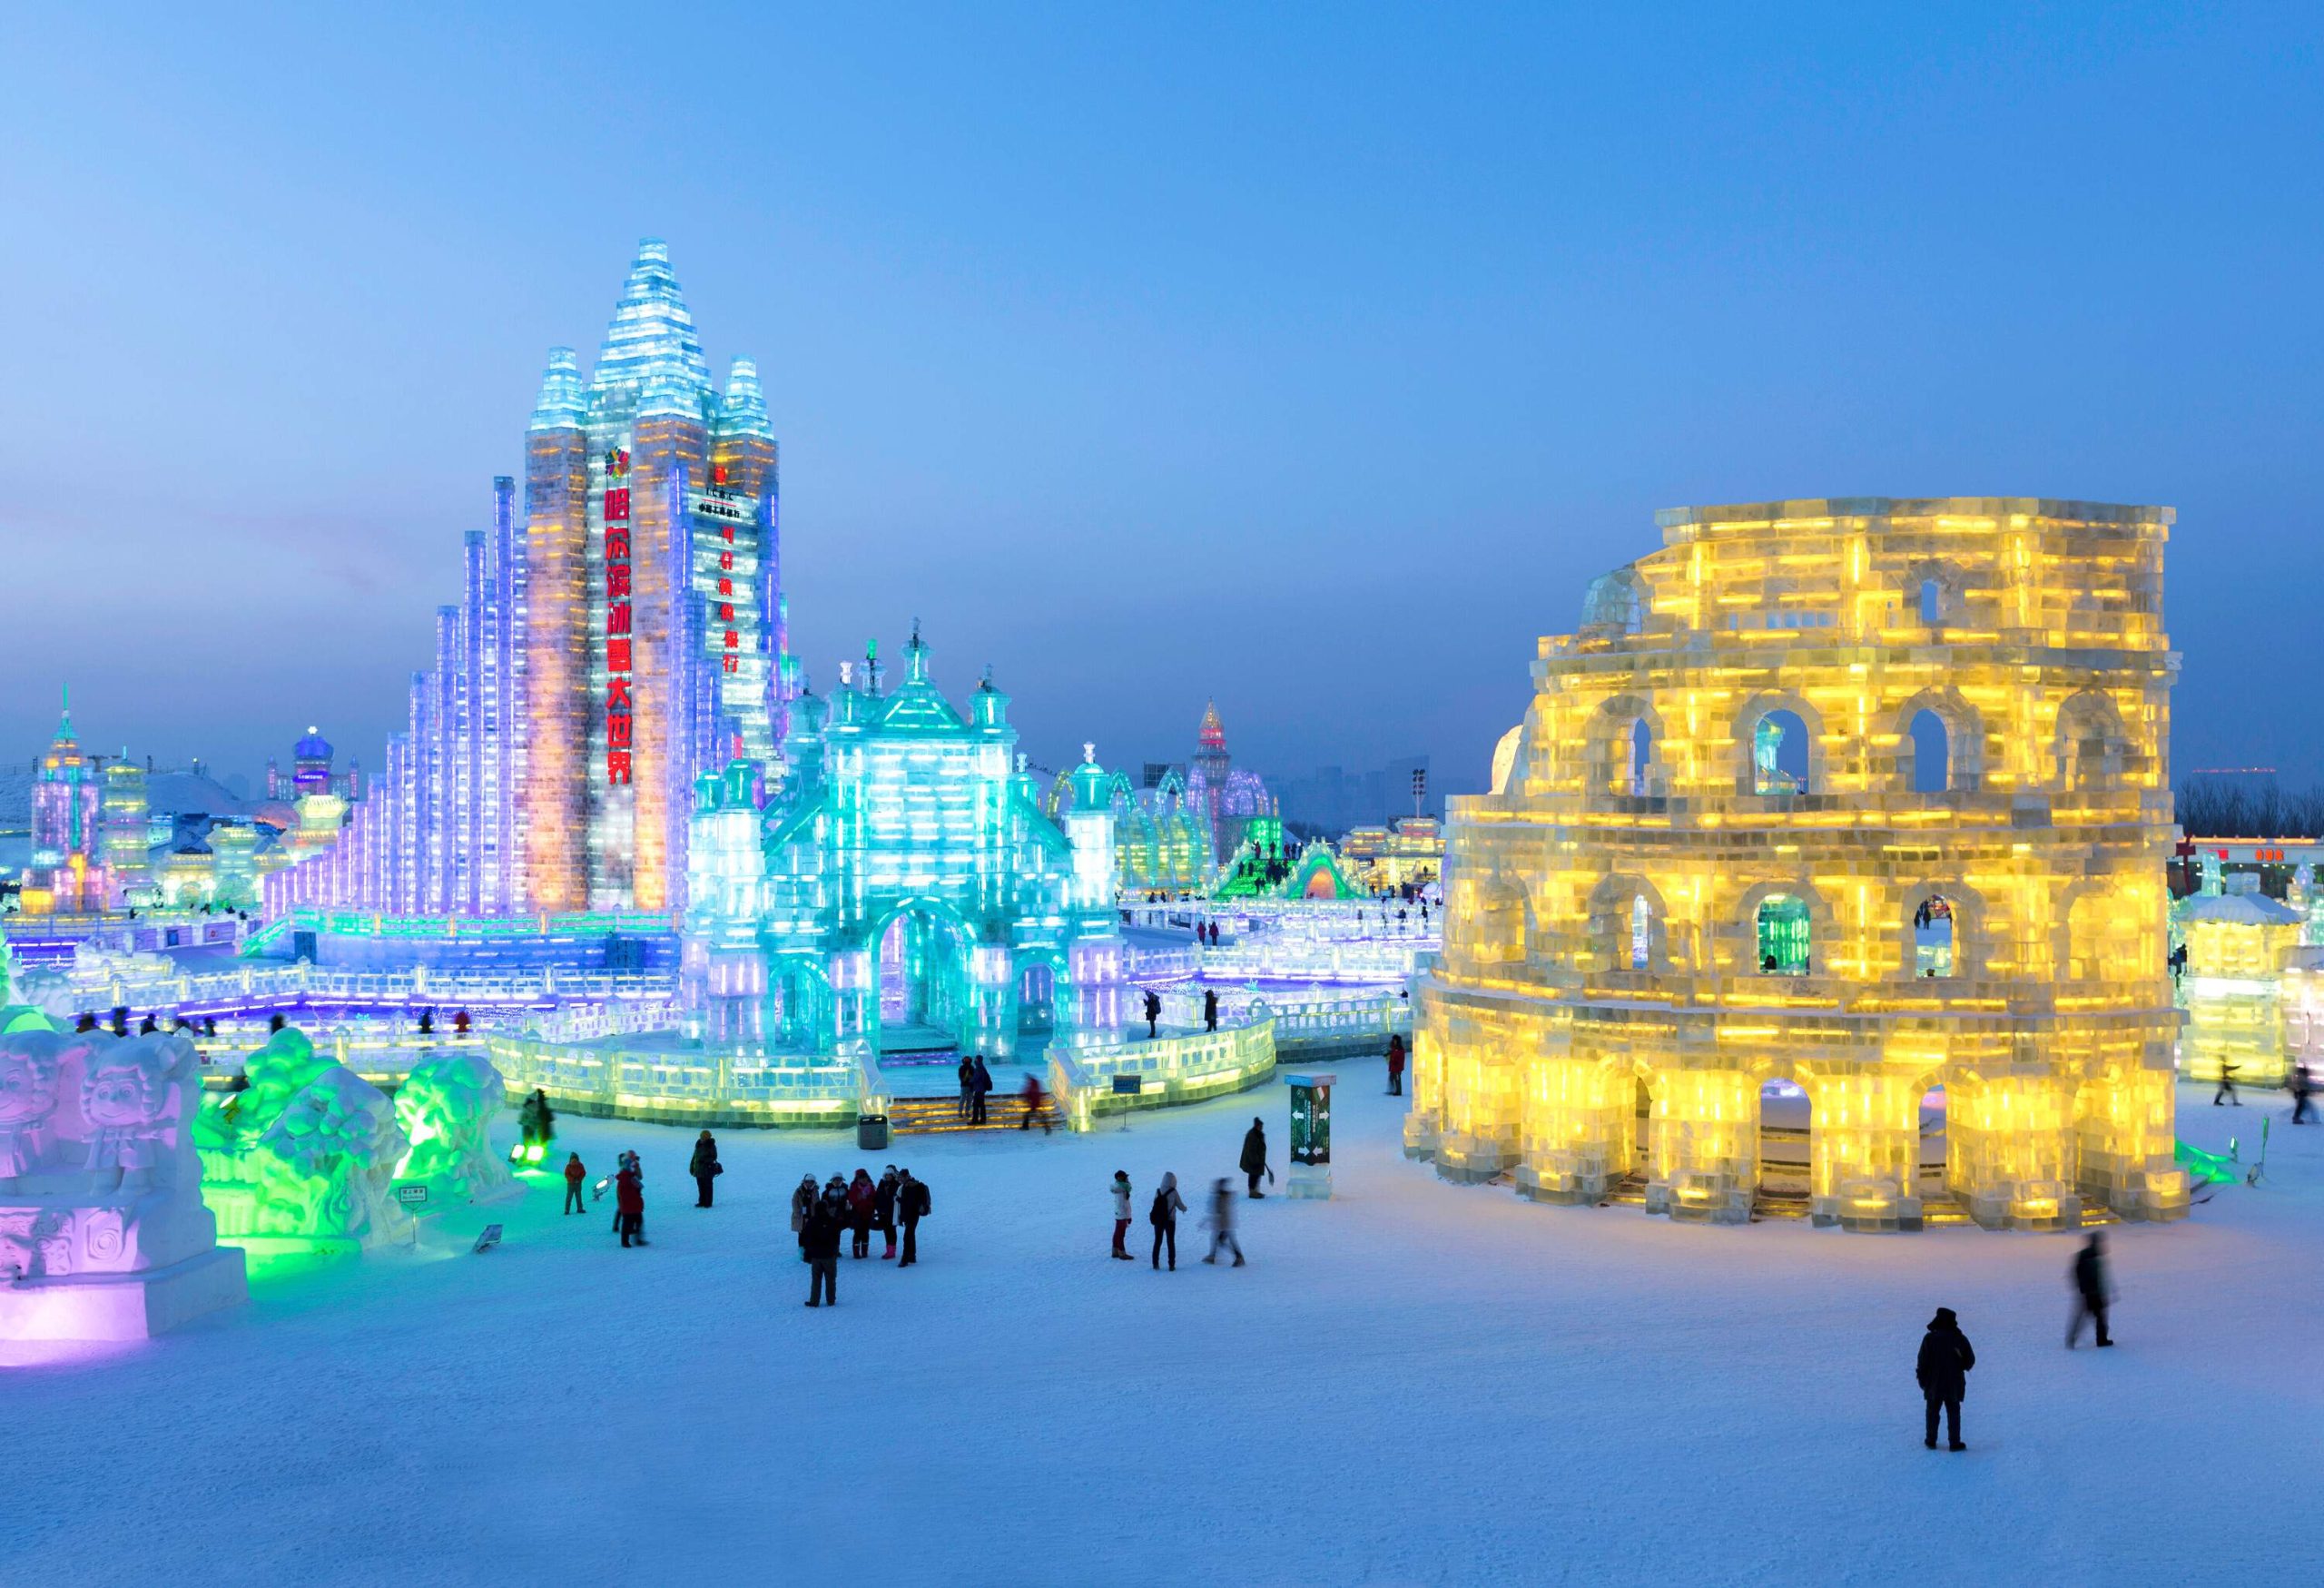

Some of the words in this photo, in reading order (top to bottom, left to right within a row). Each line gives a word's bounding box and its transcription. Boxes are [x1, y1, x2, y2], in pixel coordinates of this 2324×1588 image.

[604, 488, 632, 785] 哈尔滨冰雪大世界
